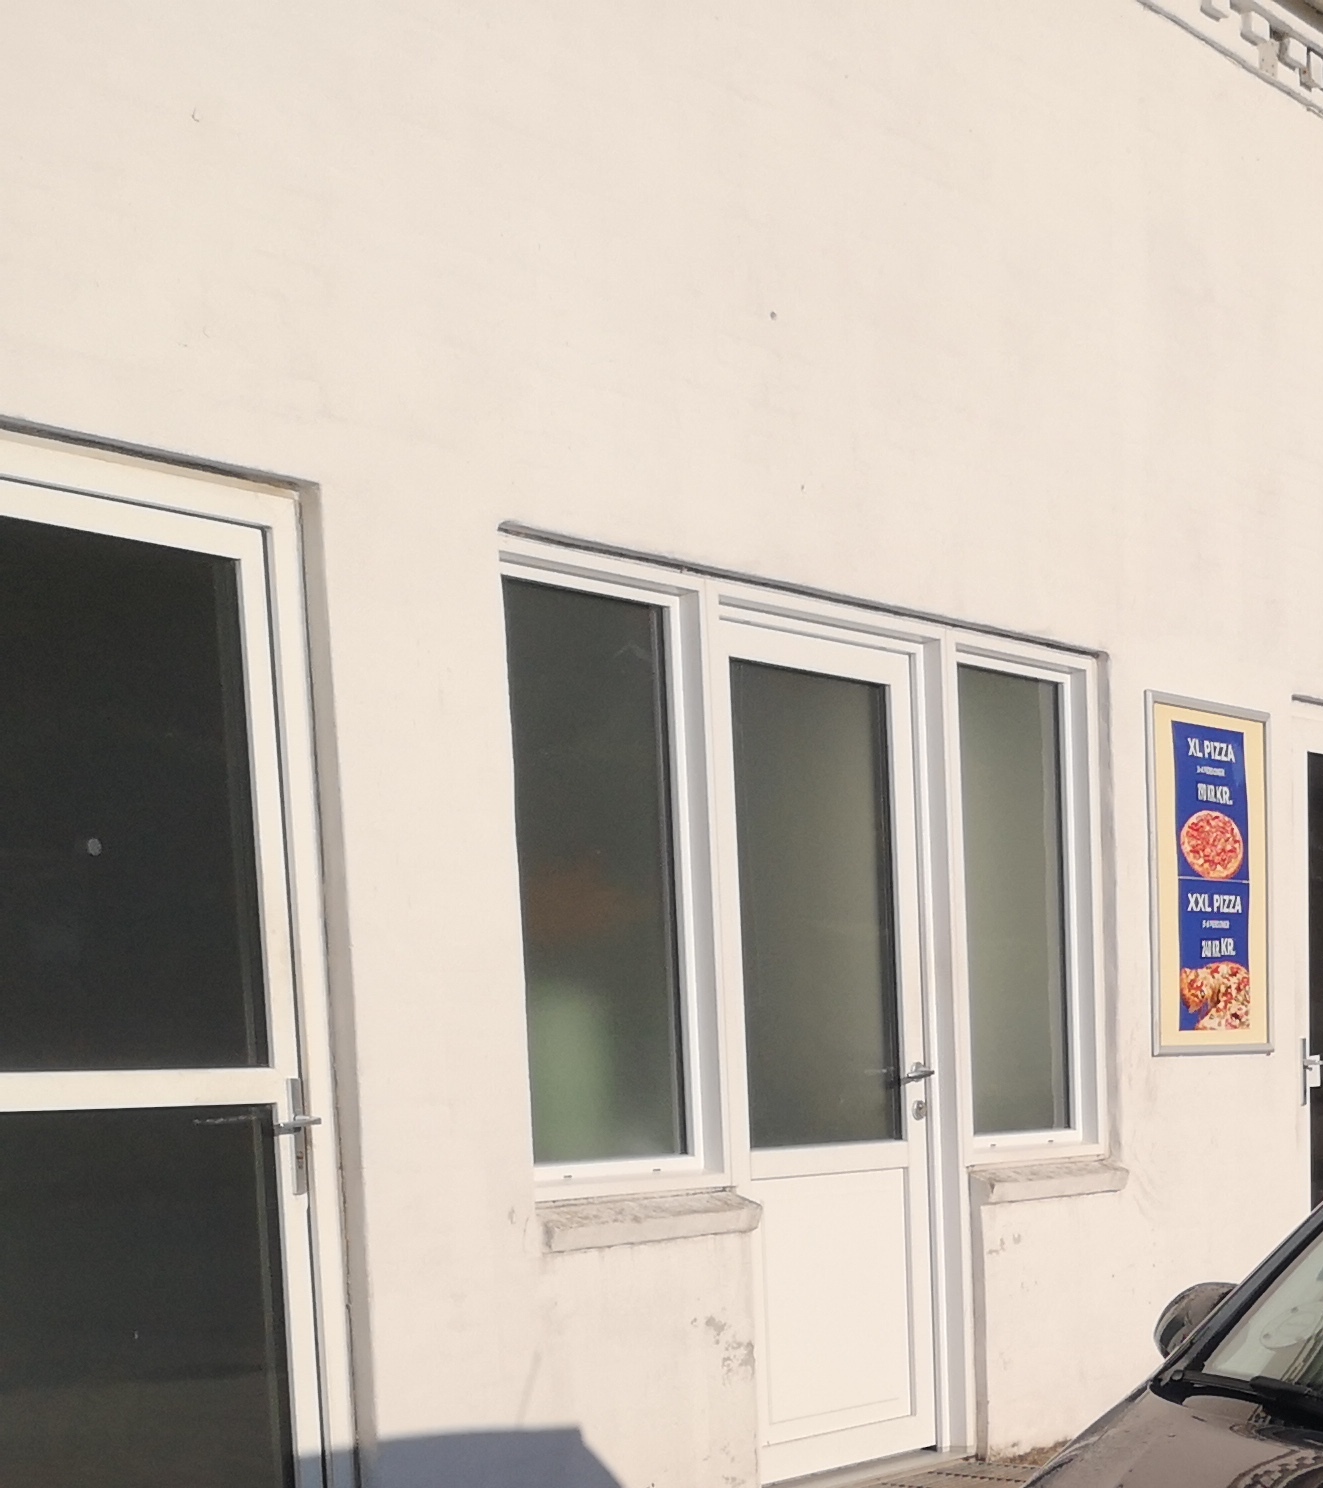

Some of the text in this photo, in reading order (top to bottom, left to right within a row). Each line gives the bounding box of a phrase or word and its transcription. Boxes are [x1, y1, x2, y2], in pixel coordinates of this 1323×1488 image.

[1187, 738, 1235, 763] XL PIZZA
[1187, 893, 1242, 914] XXL PIZZA
